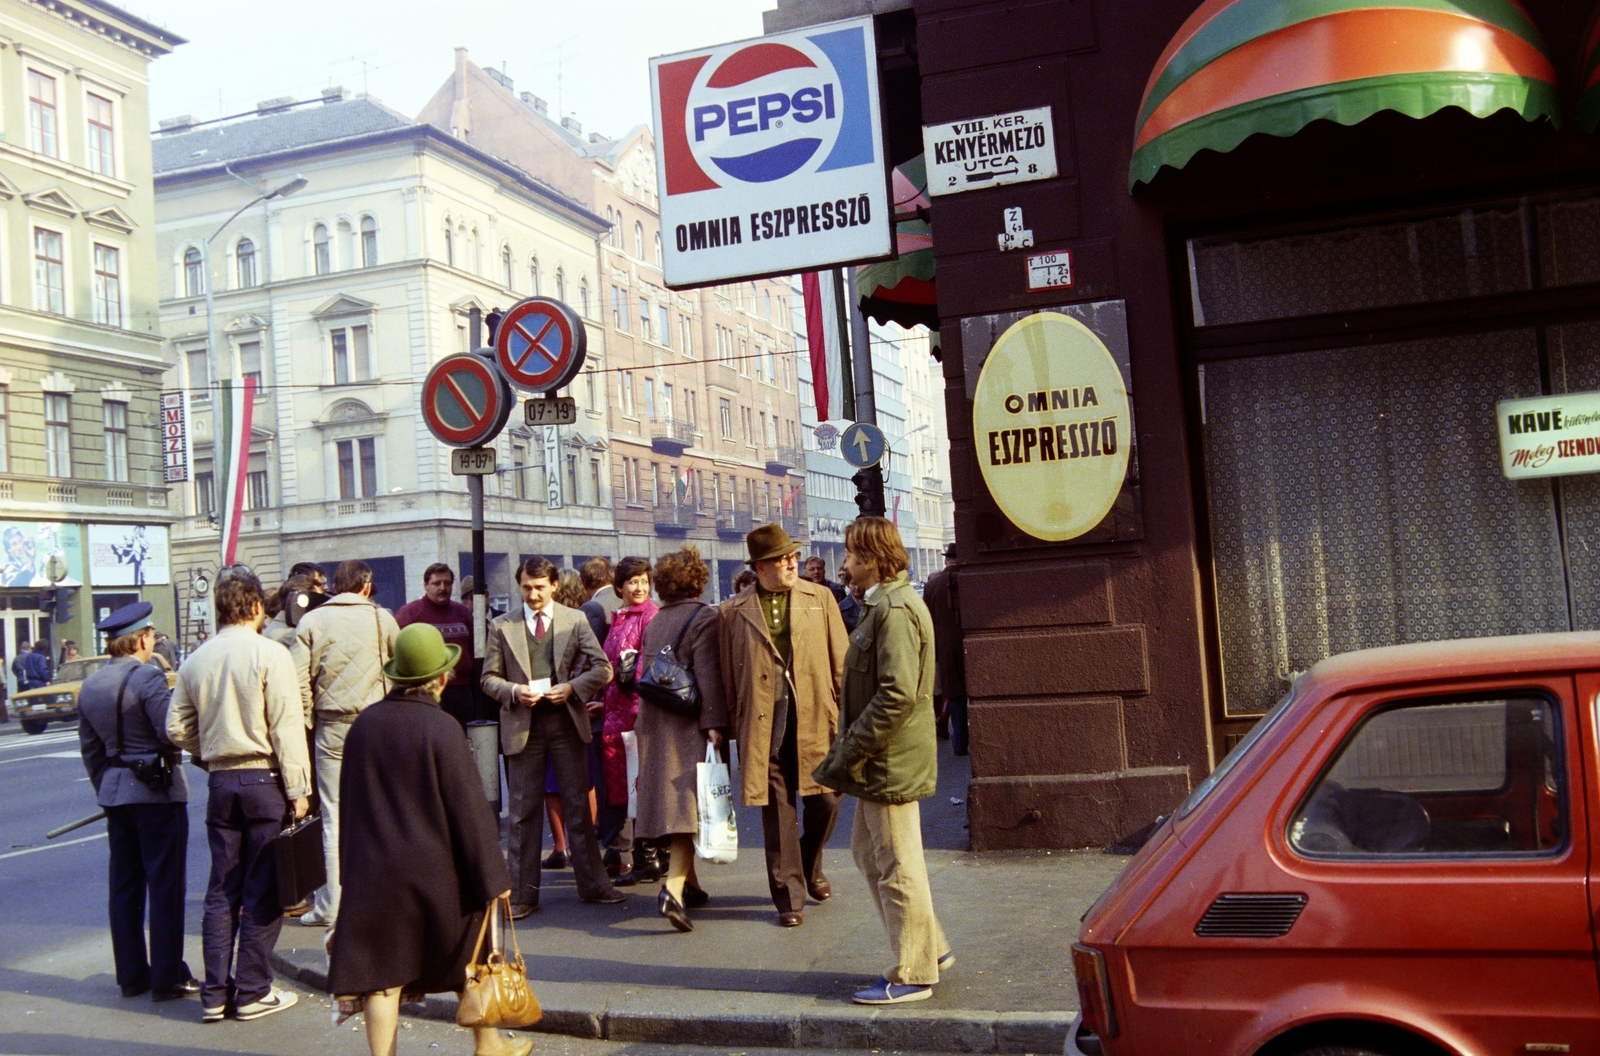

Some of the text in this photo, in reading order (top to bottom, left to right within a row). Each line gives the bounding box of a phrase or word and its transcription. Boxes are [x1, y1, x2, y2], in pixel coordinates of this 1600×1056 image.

[693, 83, 836, 142] PEPSI
[952, 115, 1029, 135] VIII. KER.
[934, 121, 1046, 165] KENYÉRMEZŐ
[948, 163, 1038, 187] 2 8
[964, 155, 1019, 172] UTCA
[1009, 211, 1018, 222] Z
[675, 215, 742, 253] OMNIA
[1028, 254, 1057, 266] T 100
[1004, 386, 1099, 414] OMNIA
[1508, 407, 1600, 435] KÁVÉ különle
[165, 409, 180, 465] MOZI
[1509, 444, 1555, 469] Meleg
